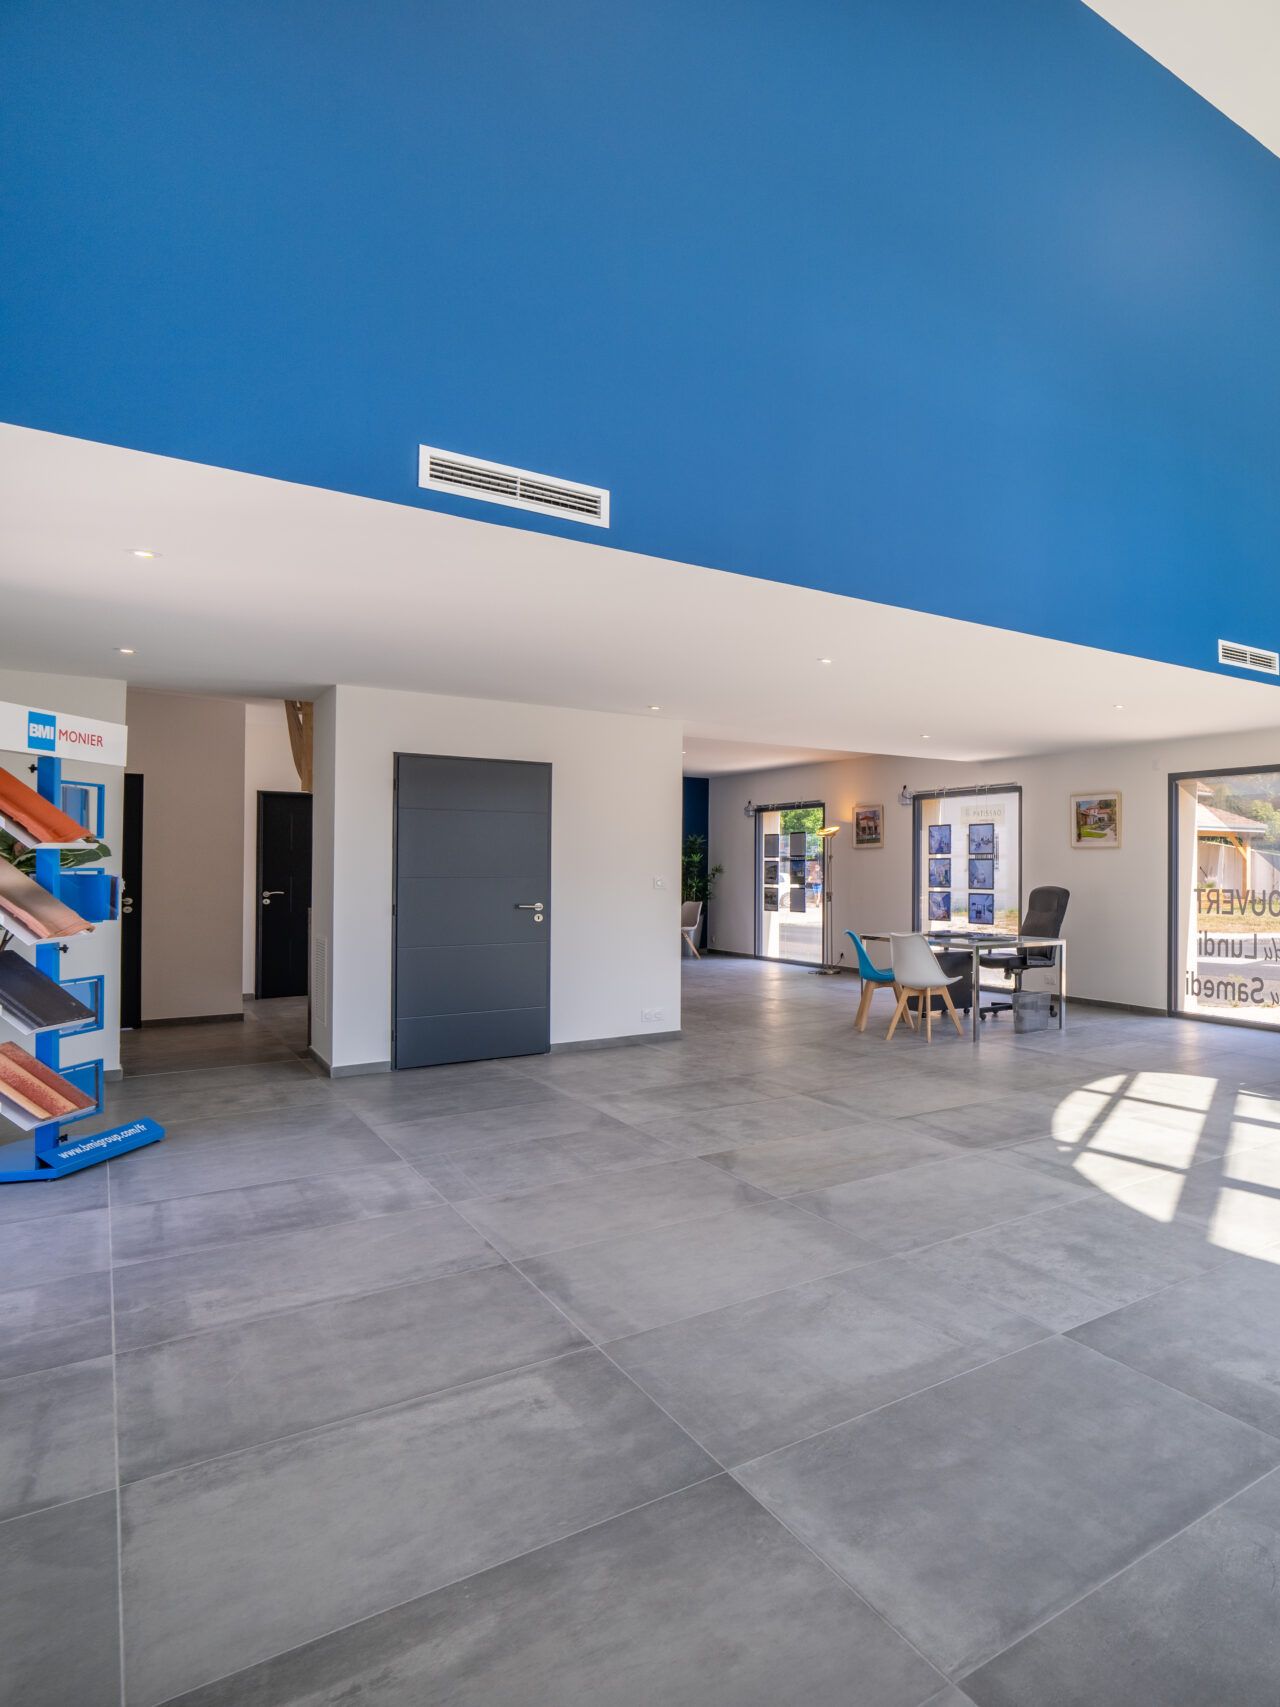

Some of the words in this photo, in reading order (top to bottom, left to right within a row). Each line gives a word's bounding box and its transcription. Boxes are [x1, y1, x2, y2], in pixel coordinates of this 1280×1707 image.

[29, 722, 55, 740] BMI
[58, 729, 104, 747] MONIER
[58, 1123, 148, 1159] www.bmigroup.com/fr
